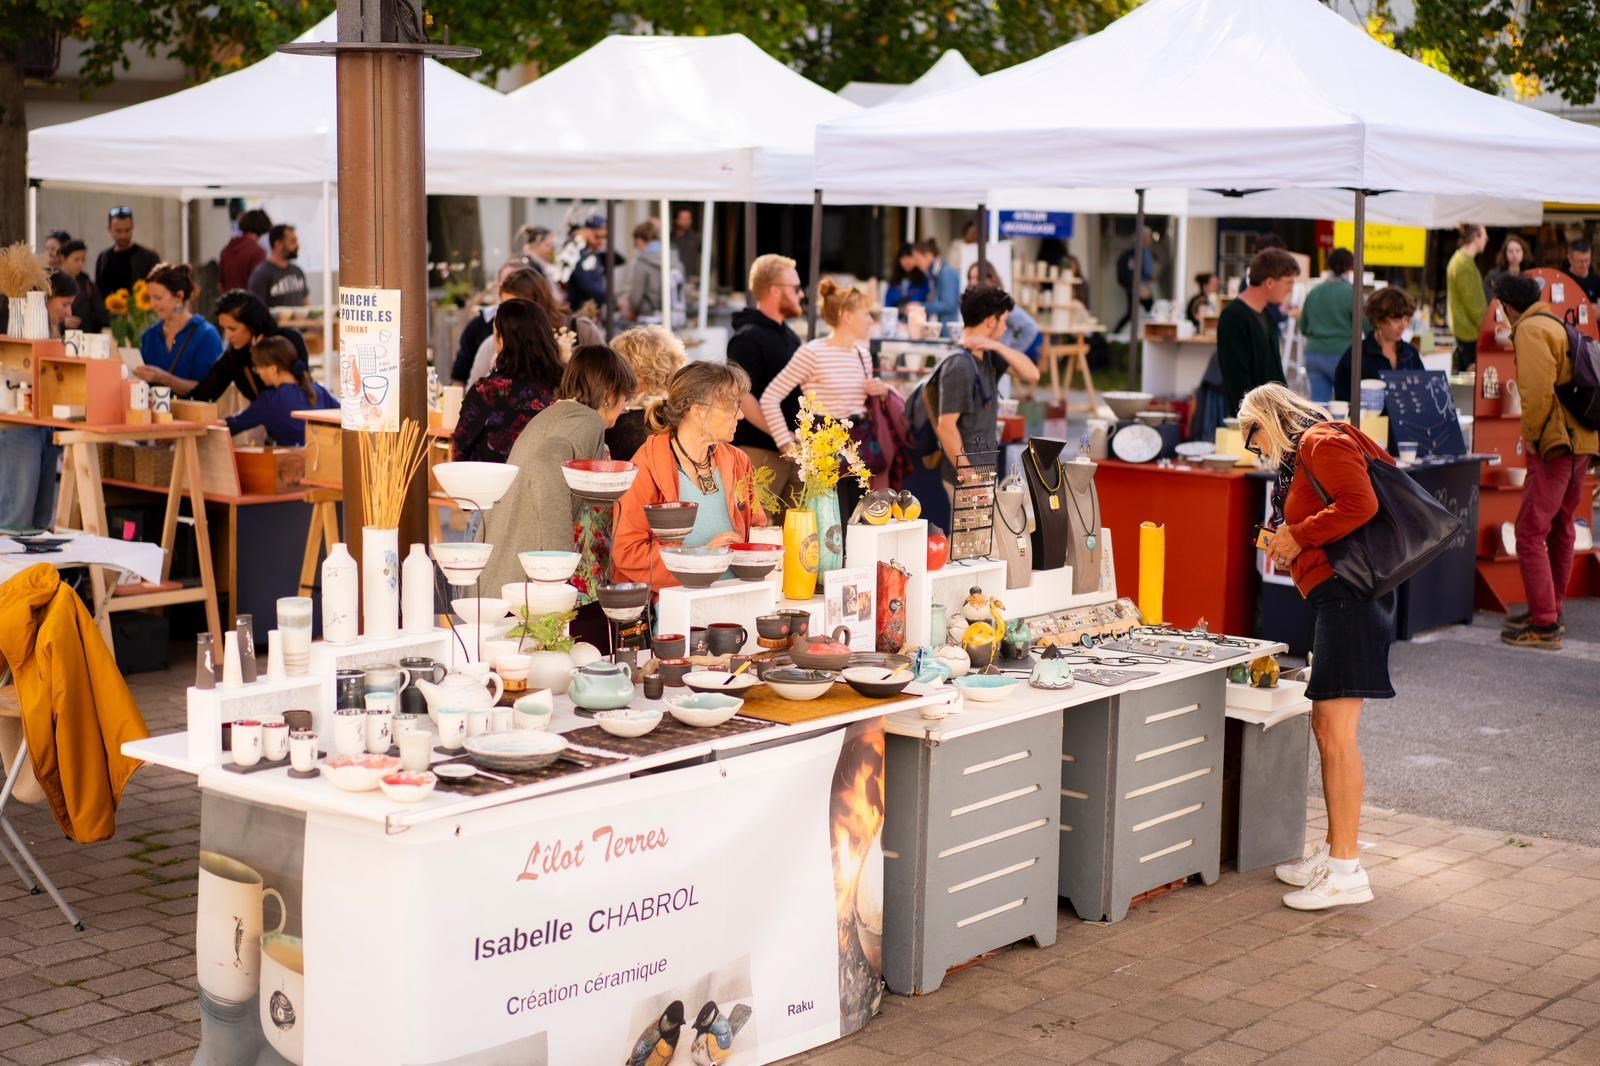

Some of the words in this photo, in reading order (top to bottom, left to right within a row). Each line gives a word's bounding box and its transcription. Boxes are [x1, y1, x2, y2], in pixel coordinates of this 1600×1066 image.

[341, 293, 377, 307] MARCHÉ
[592, 825, 669, 863] Terres
[474, 919, 573, 961] Isabelle
[588, 885, 699, 934] CHABROL
[506, 983, 578, 1015] Création
[584, 957, 667, 994] céramique
[788, 1000, 814, 1016] Raku
